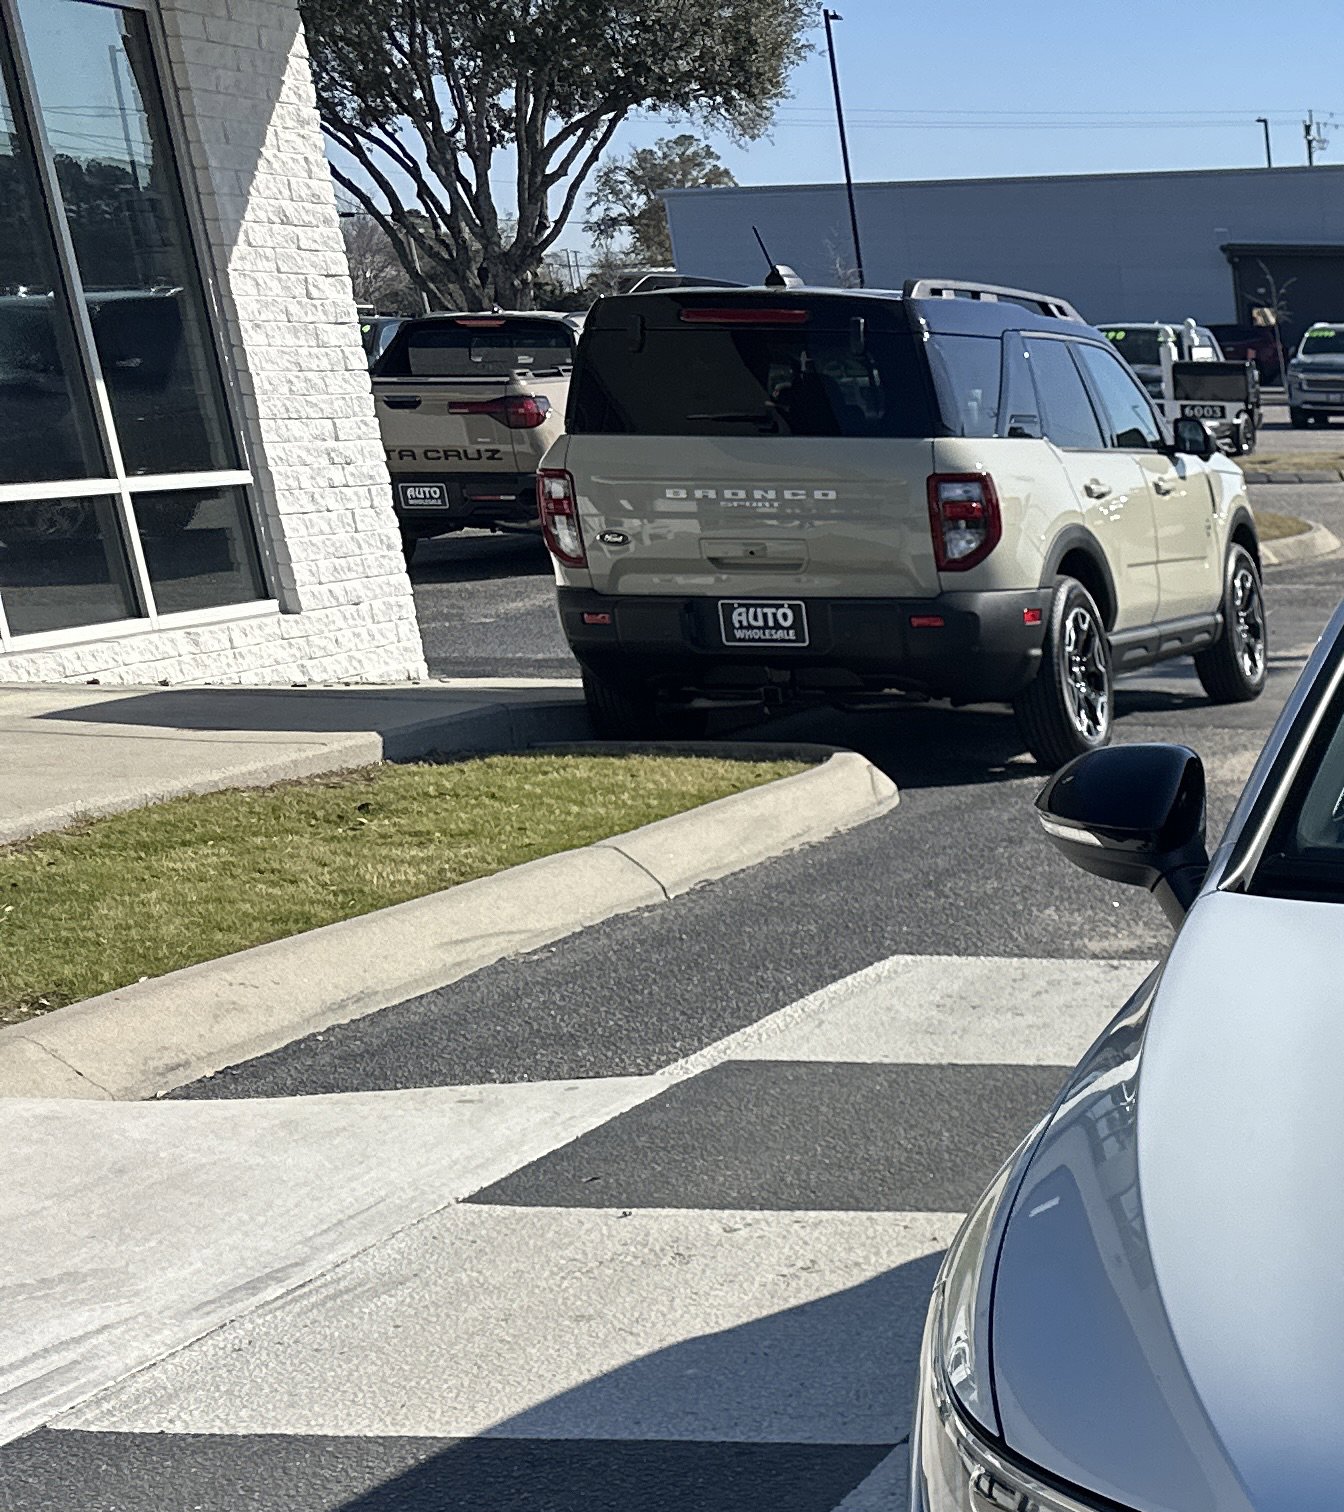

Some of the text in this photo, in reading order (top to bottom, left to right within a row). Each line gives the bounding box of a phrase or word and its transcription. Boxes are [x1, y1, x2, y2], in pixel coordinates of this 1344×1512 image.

[1184, 406, 1222, 418] 6003
[423, 449, 504, 460] CRUZ
[406, 486, 441, 499] AUTO
[665, 488, 837, 500] BRONCO
[731, 606, 794, 628] AUTO
[734, 628, 796, 640] WHOLESALE
